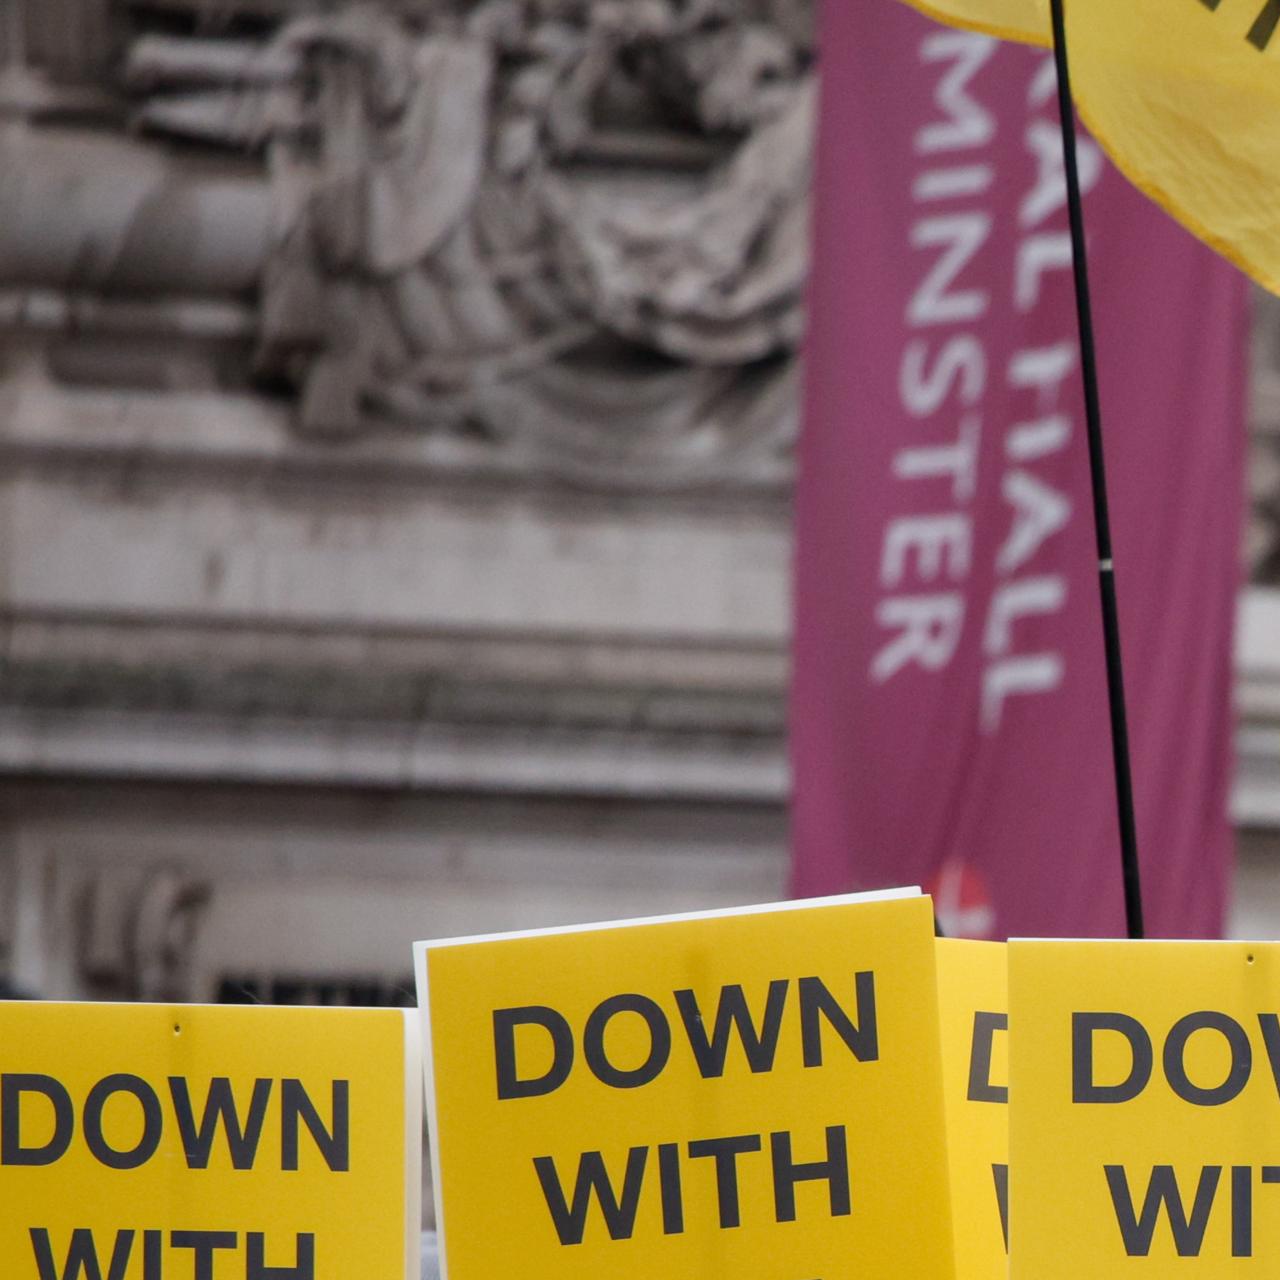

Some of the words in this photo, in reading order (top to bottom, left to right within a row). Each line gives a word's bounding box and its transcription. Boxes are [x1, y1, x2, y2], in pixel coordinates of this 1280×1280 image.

[872, 28, 1002, 686] MINSTER
[493, 971, 878, 1100] DOWN
[1, 1074, 349, 1171] DOWN
[533, 1125, 850, 1245] WITH
